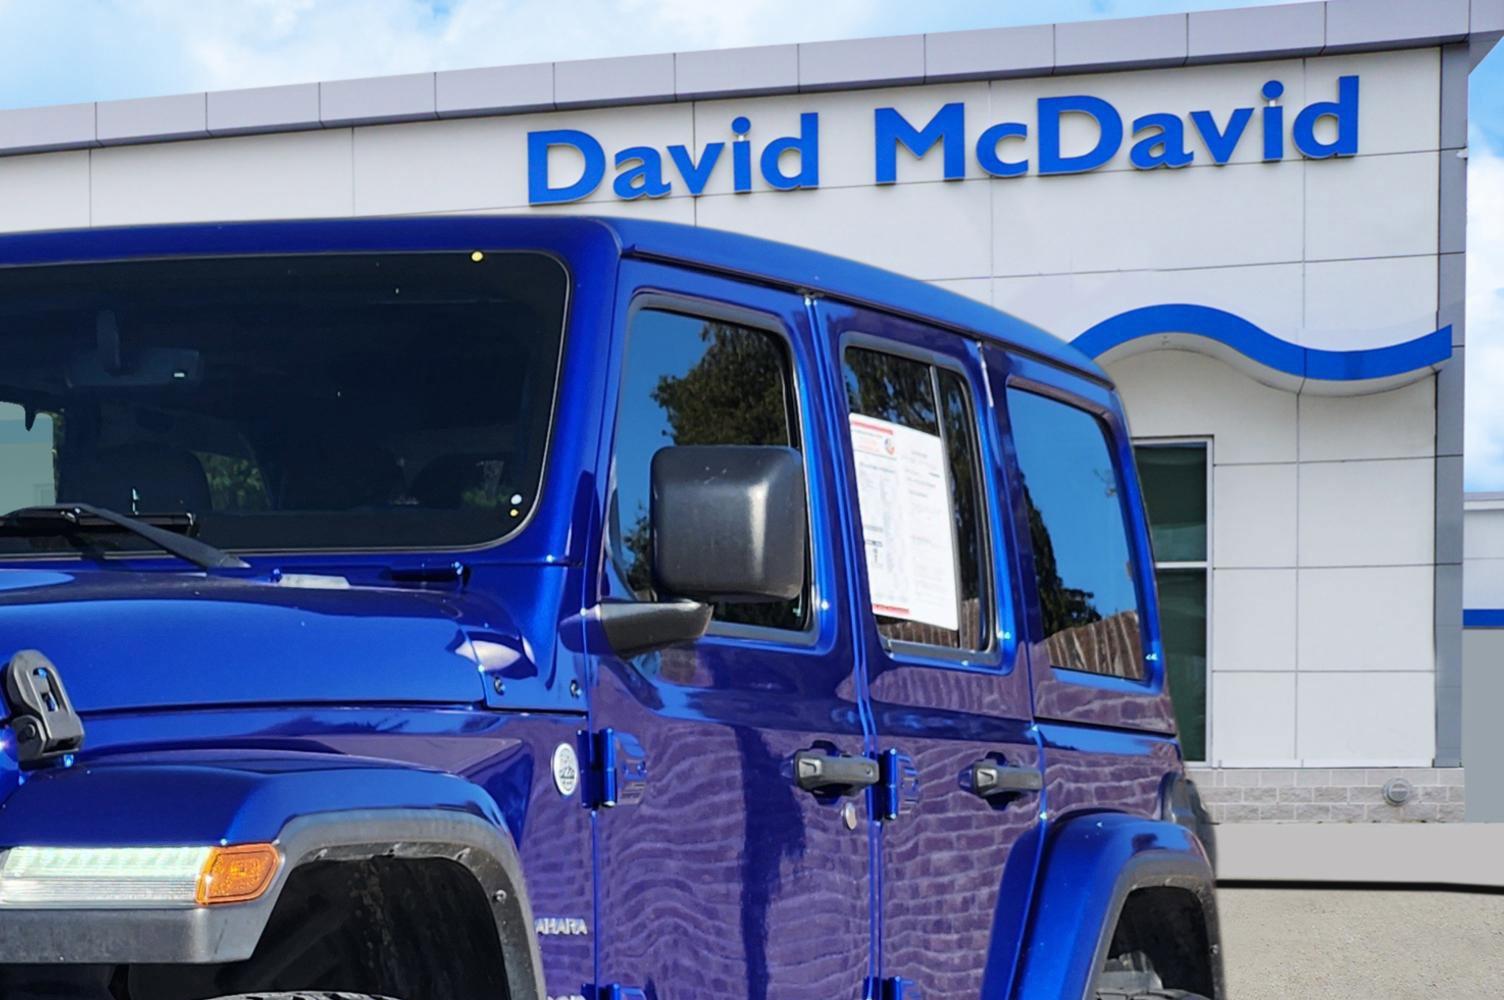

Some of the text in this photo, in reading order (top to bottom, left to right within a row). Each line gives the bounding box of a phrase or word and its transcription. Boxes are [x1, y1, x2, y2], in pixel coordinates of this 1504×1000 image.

[527, 75, 1360, 206] David McDavid
[535, 918, 588, 935] AHARA
